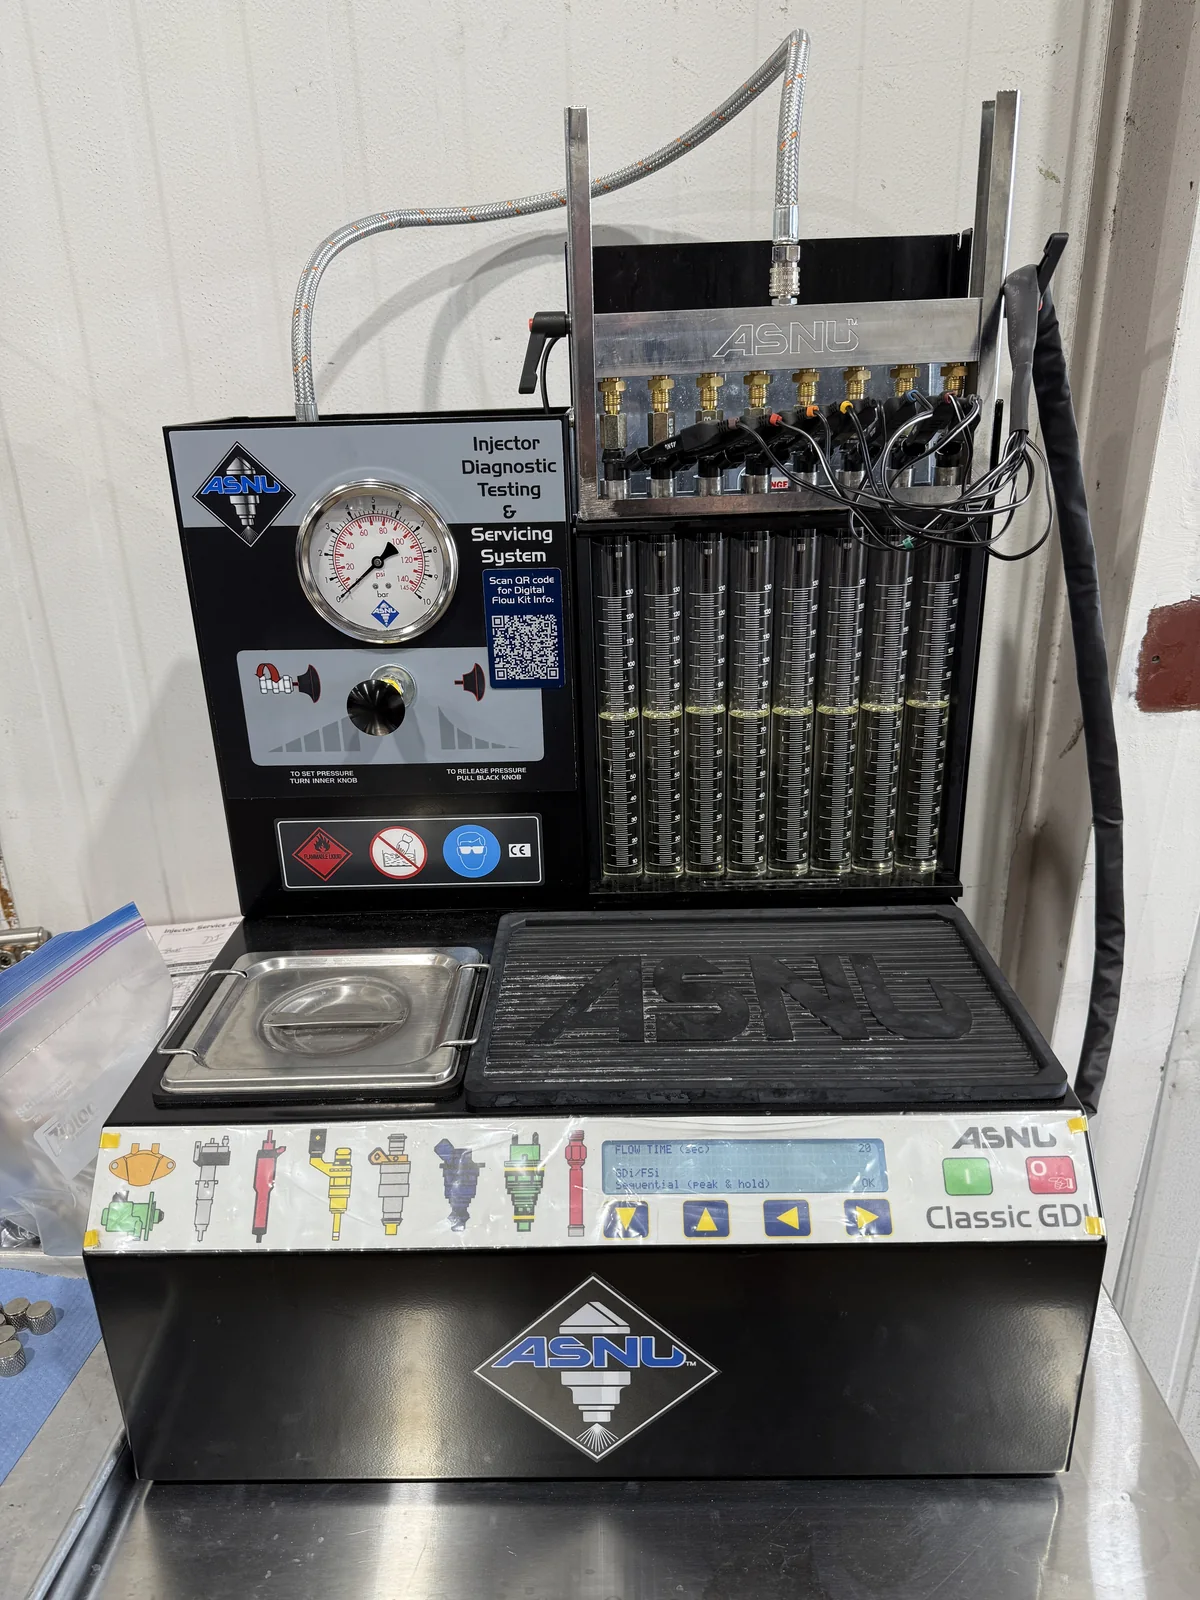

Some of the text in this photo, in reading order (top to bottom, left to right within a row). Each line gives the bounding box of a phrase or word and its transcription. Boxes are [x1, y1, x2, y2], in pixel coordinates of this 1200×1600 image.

[712, 320, 859, 358] ASNU
[473, 436, 540, 454] Injector
[462, 458, 557, 478] Diagnostic
[200, 475, 281, 494] ASNU
[477, 482, 541, 500] Testing
[503, 504, 516, 519] &
[471, 526, 553, 544] Servicing
[480, 548, 547, 566] System
[489, 576, 555, 585] Scan QR code
[514, 586, 545, 595] Digital
[533, 595, 554, 603] Info:
[511, 845, 526, 855] CE
[526, 954, 974, 1043] ASNU
[952, 1126, 1057, 1150] ASNU
[615, 1143, 872, 1154] FLOW TIME (sec) 20
[615, 1168, 660, 1178] GDi/FSi
[615, 1180, 679, 1190] Sequential
[738, 1179, 770, 1189] hold)
[862, 1178, 875, 1188] OK
[926, 1205, 1032, 1229] Classic
[491, 1336, 686, 1368] ASNU
